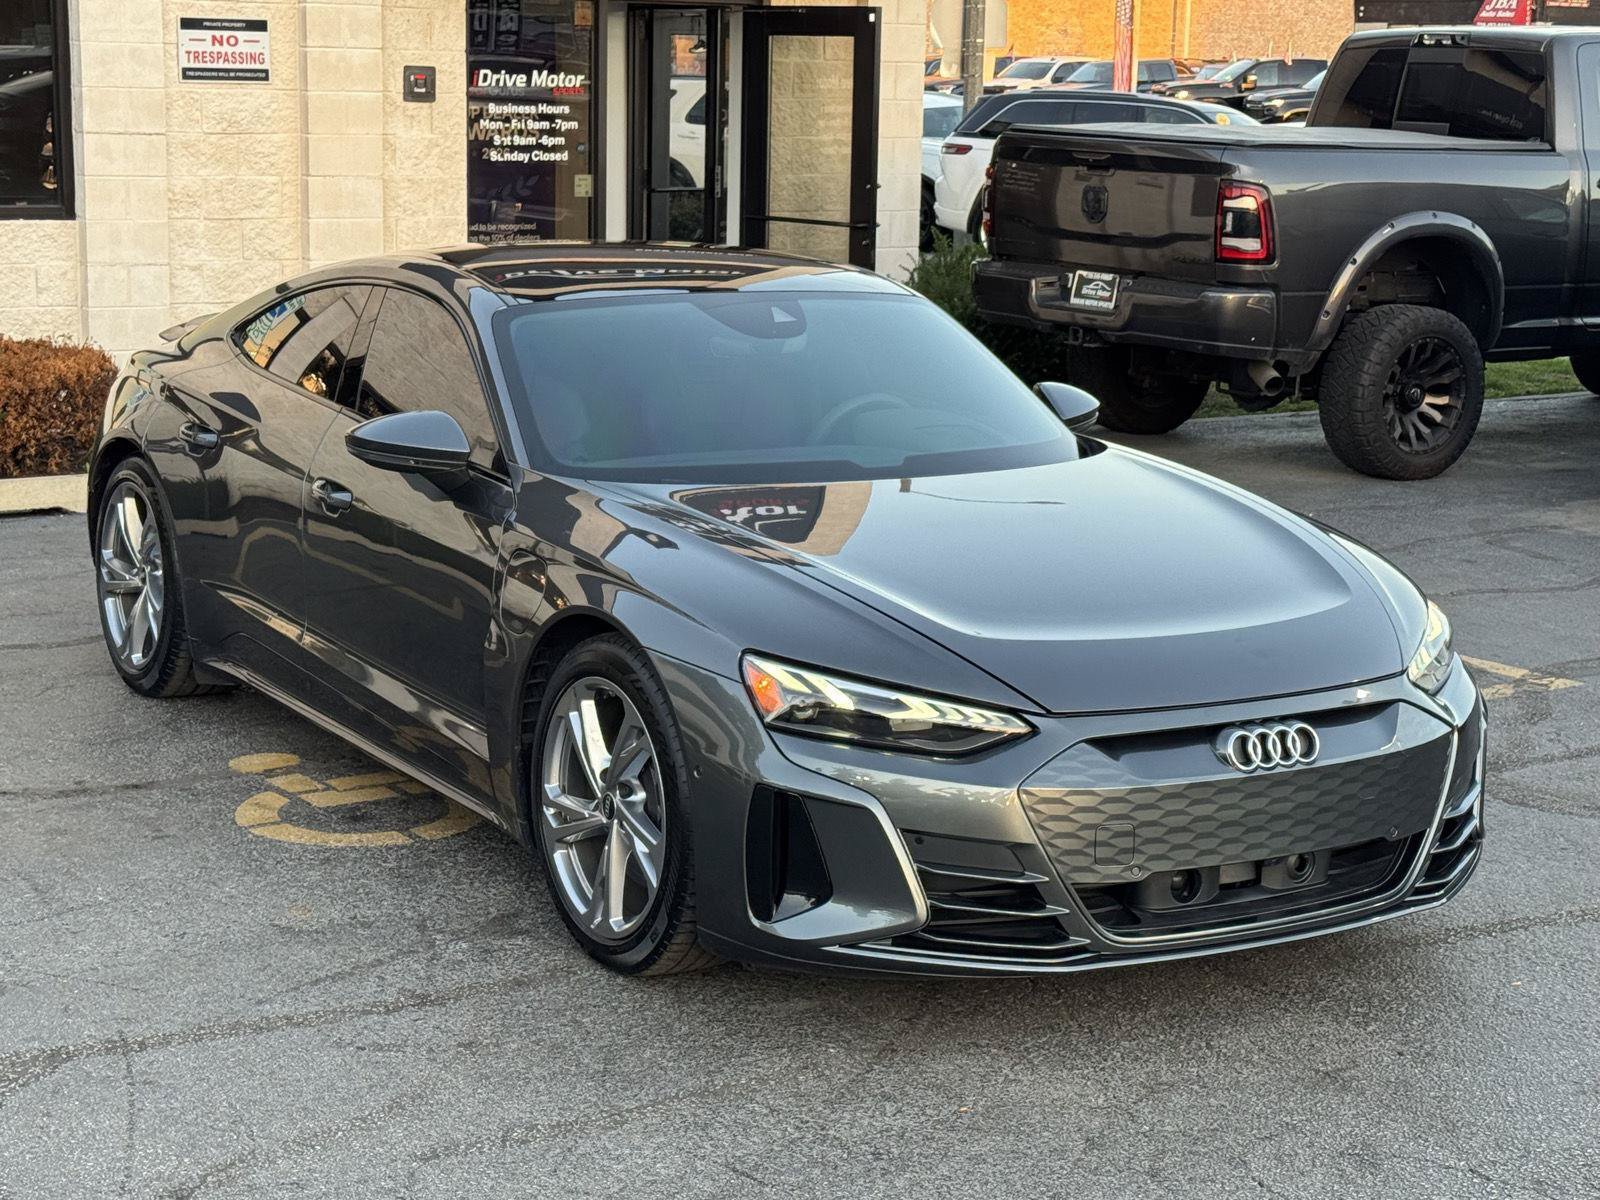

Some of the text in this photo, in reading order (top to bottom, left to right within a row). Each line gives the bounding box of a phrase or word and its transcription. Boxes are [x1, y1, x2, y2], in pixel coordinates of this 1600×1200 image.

[211, 34, 239, 47] NO
[185, 50, 265, 65] TRESPASSING
[531, 70, 585, 87] Motor
[488, 103, 570, 114] Business Hours
[490, 150, 569, 163] Sunday Closed
